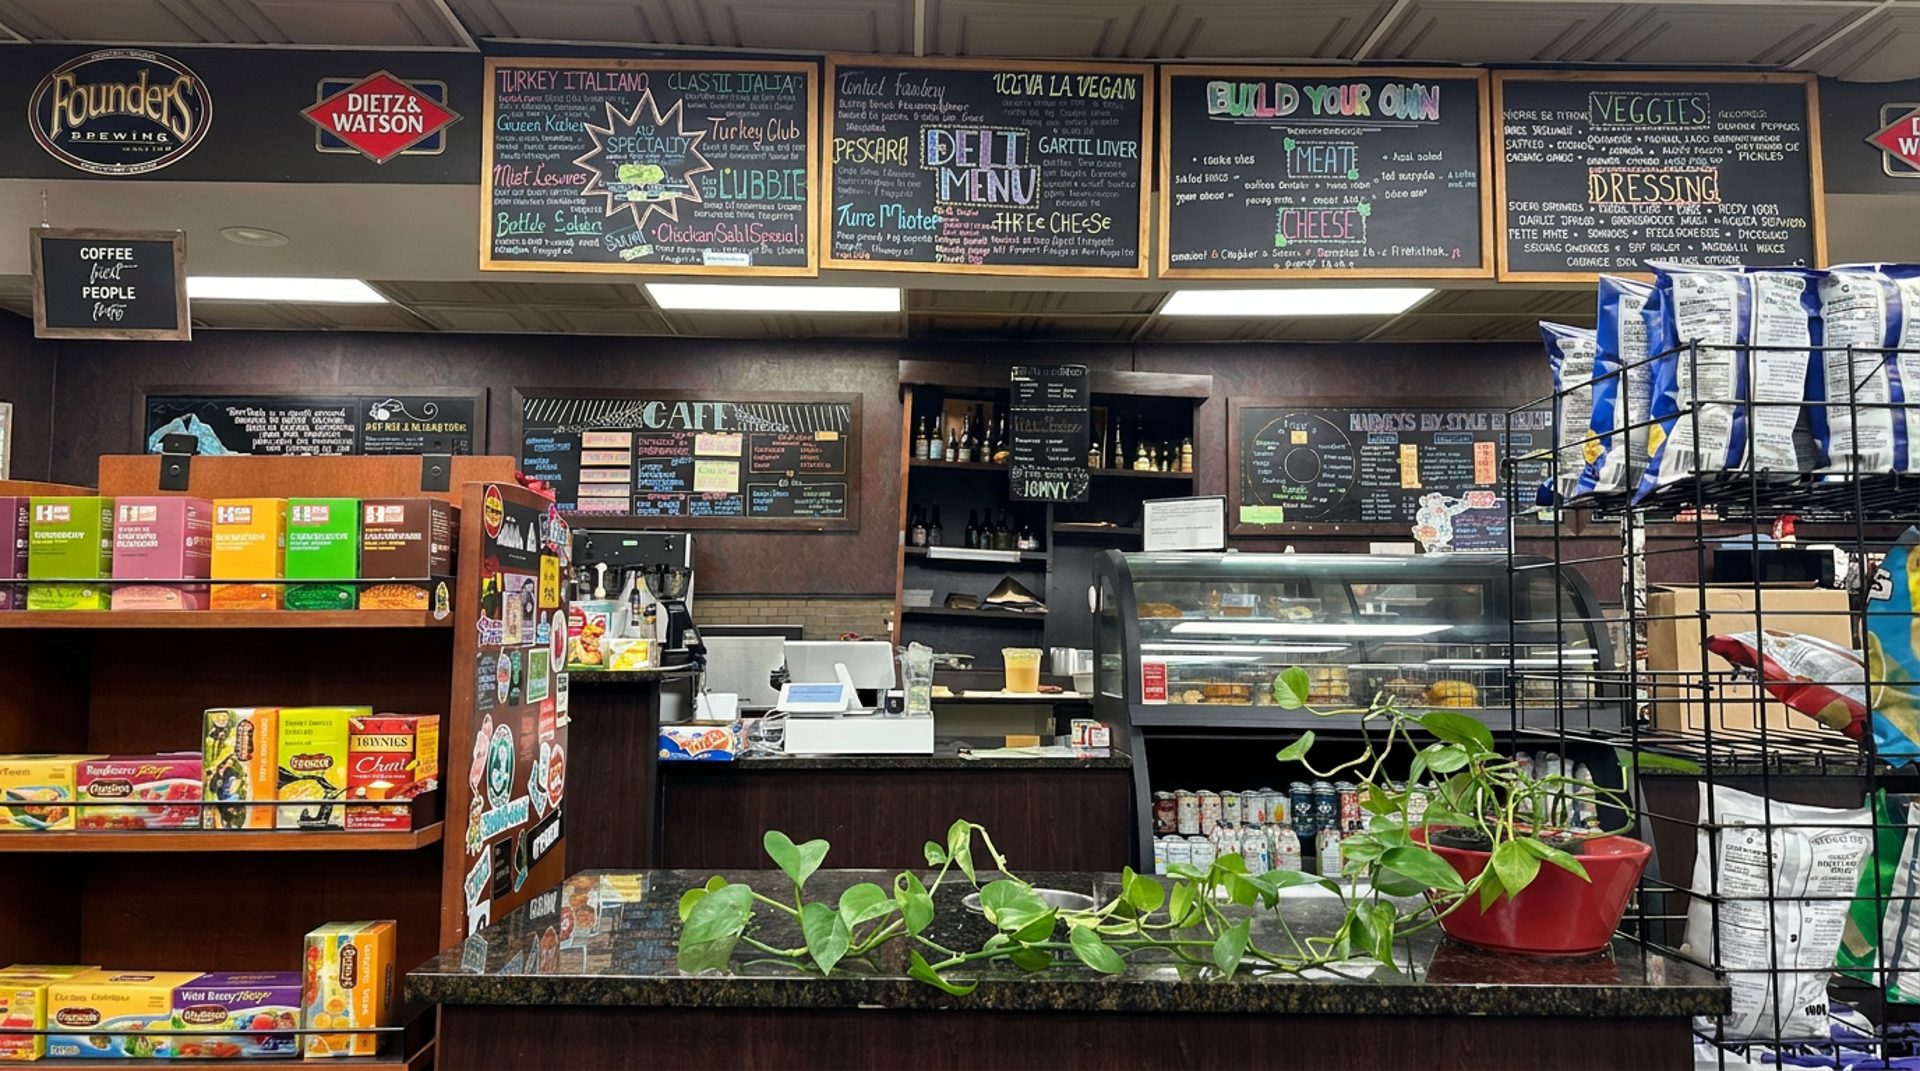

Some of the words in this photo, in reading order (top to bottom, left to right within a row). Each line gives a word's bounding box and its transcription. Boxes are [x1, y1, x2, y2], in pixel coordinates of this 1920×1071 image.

[1077, 76, 1136, 100] VEGAN
[1207, 81, 1300, 117] BUILD
[1303, 83, 1371, 116] YOUR
[1378, 83, 1440, 120] OWN
[51, 68, 194, 142] Founders
[1593, 95, 1706, 125] VEGGIES
[332, 112, 423, 133] WATSON
[706, 116, 763, 143] Turkey
[766, 117, 801, 142] Club
[941, 166, 1036, 204] MENU
[1592, 172, 1714, 203] DRESSING
[1283, 210, 1355, 239] CHEESE
[80, 247, 134, 260] COFFEE
[82, 286, 136, 299] PEOPLE
[643, 400, 738, 430] CAFE
